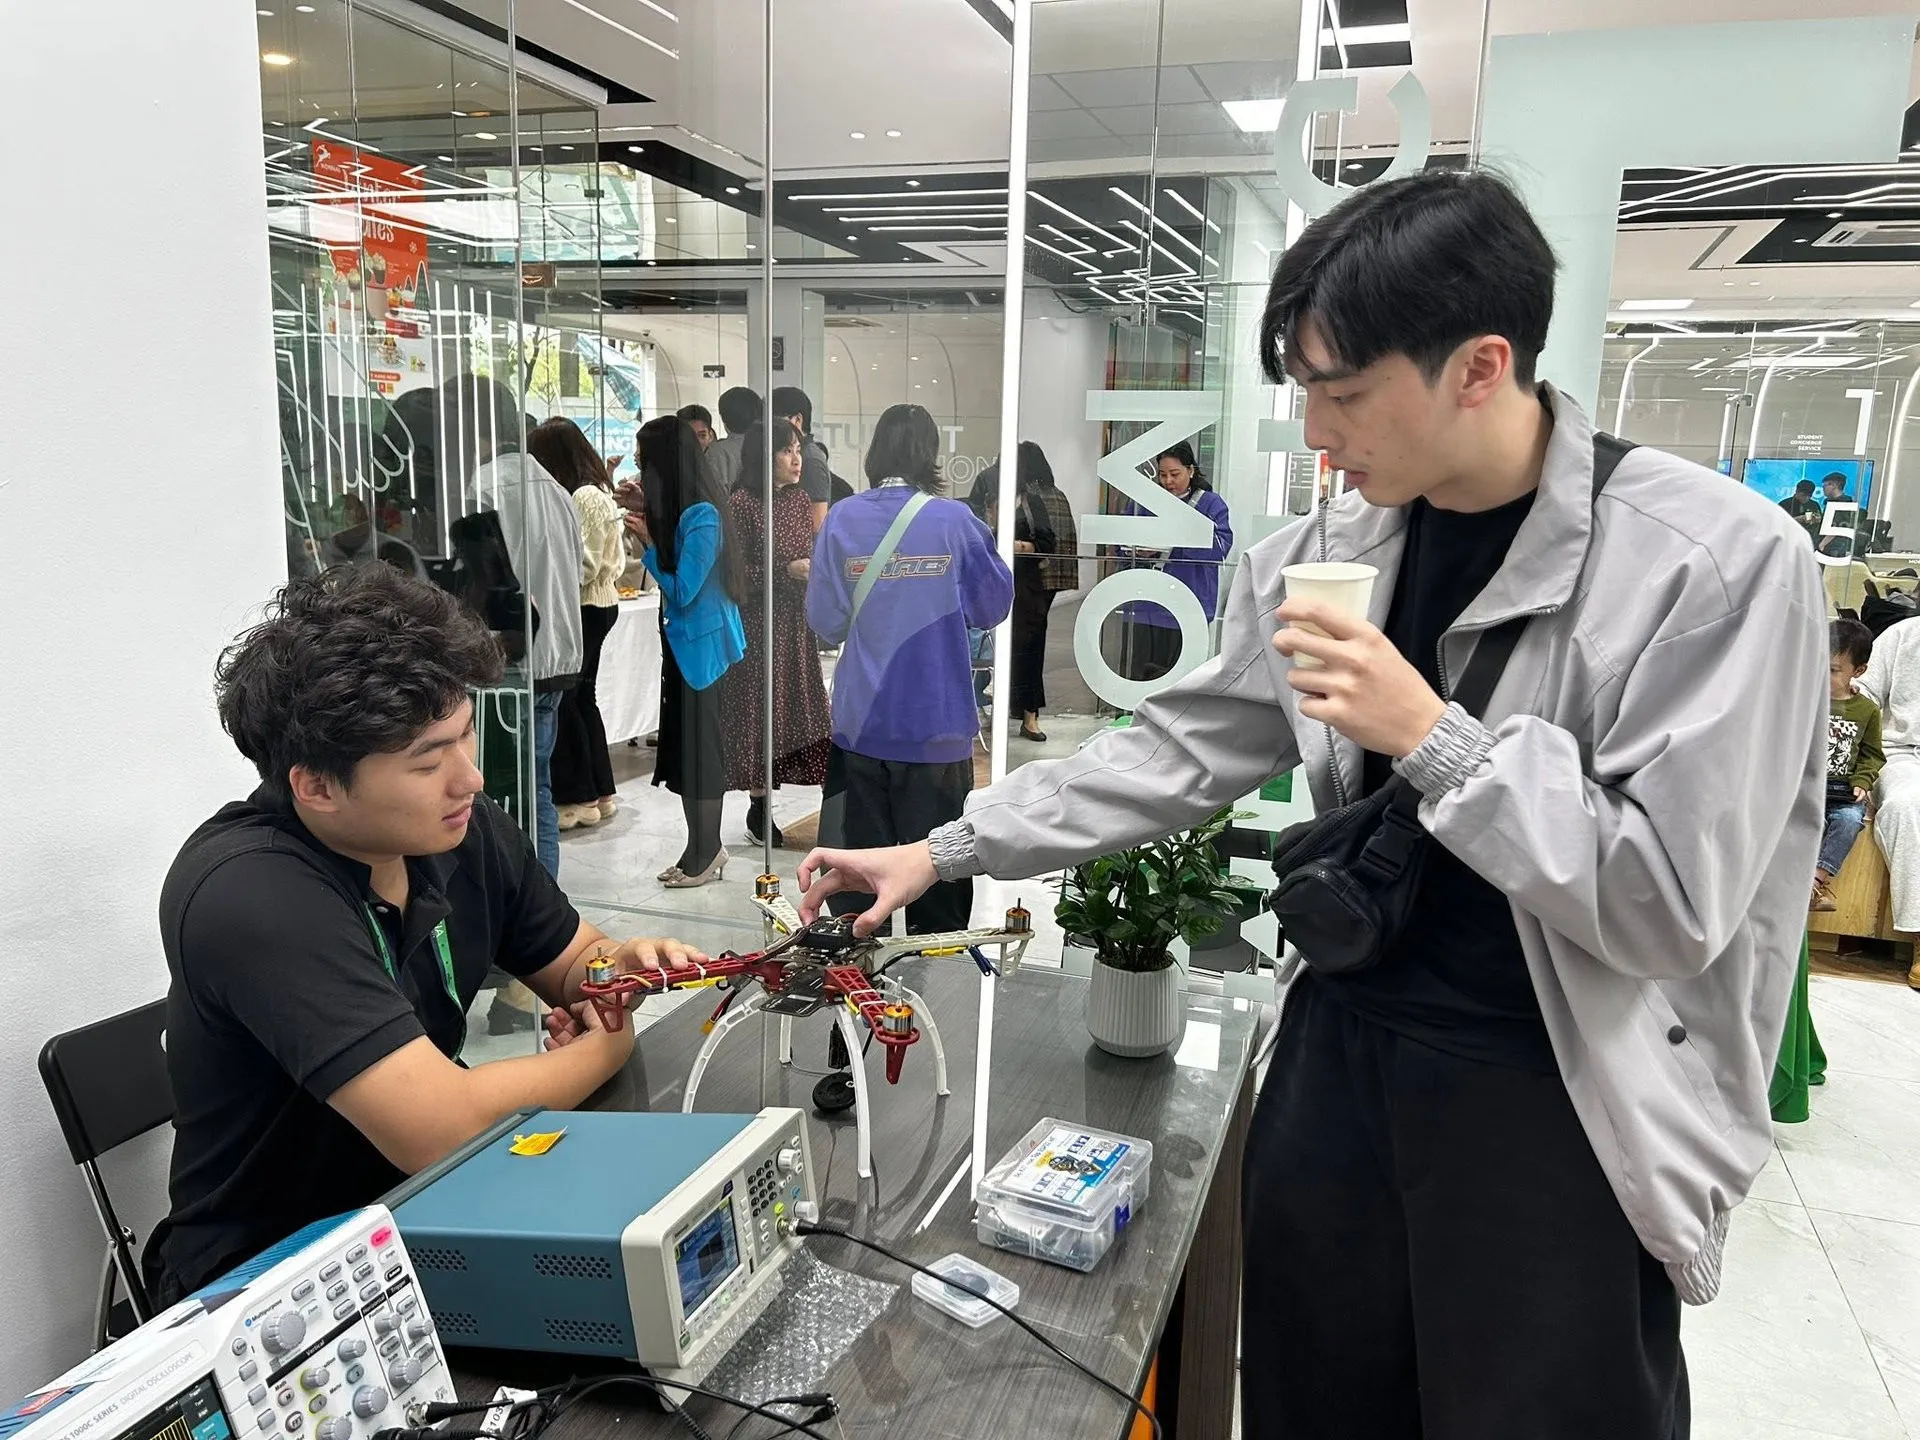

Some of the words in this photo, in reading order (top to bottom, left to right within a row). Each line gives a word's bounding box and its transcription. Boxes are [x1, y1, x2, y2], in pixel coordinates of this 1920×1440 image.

[305, 1339, 325, 1357] Vertical
[69, 1419, 93, 1438] 1000C
[93, 1403, 119, 1423] SERIES
[120, 1383, 147, 1405] DIGITAL
[147, 1351, 194, 1387] OSCILLOSCOPE
